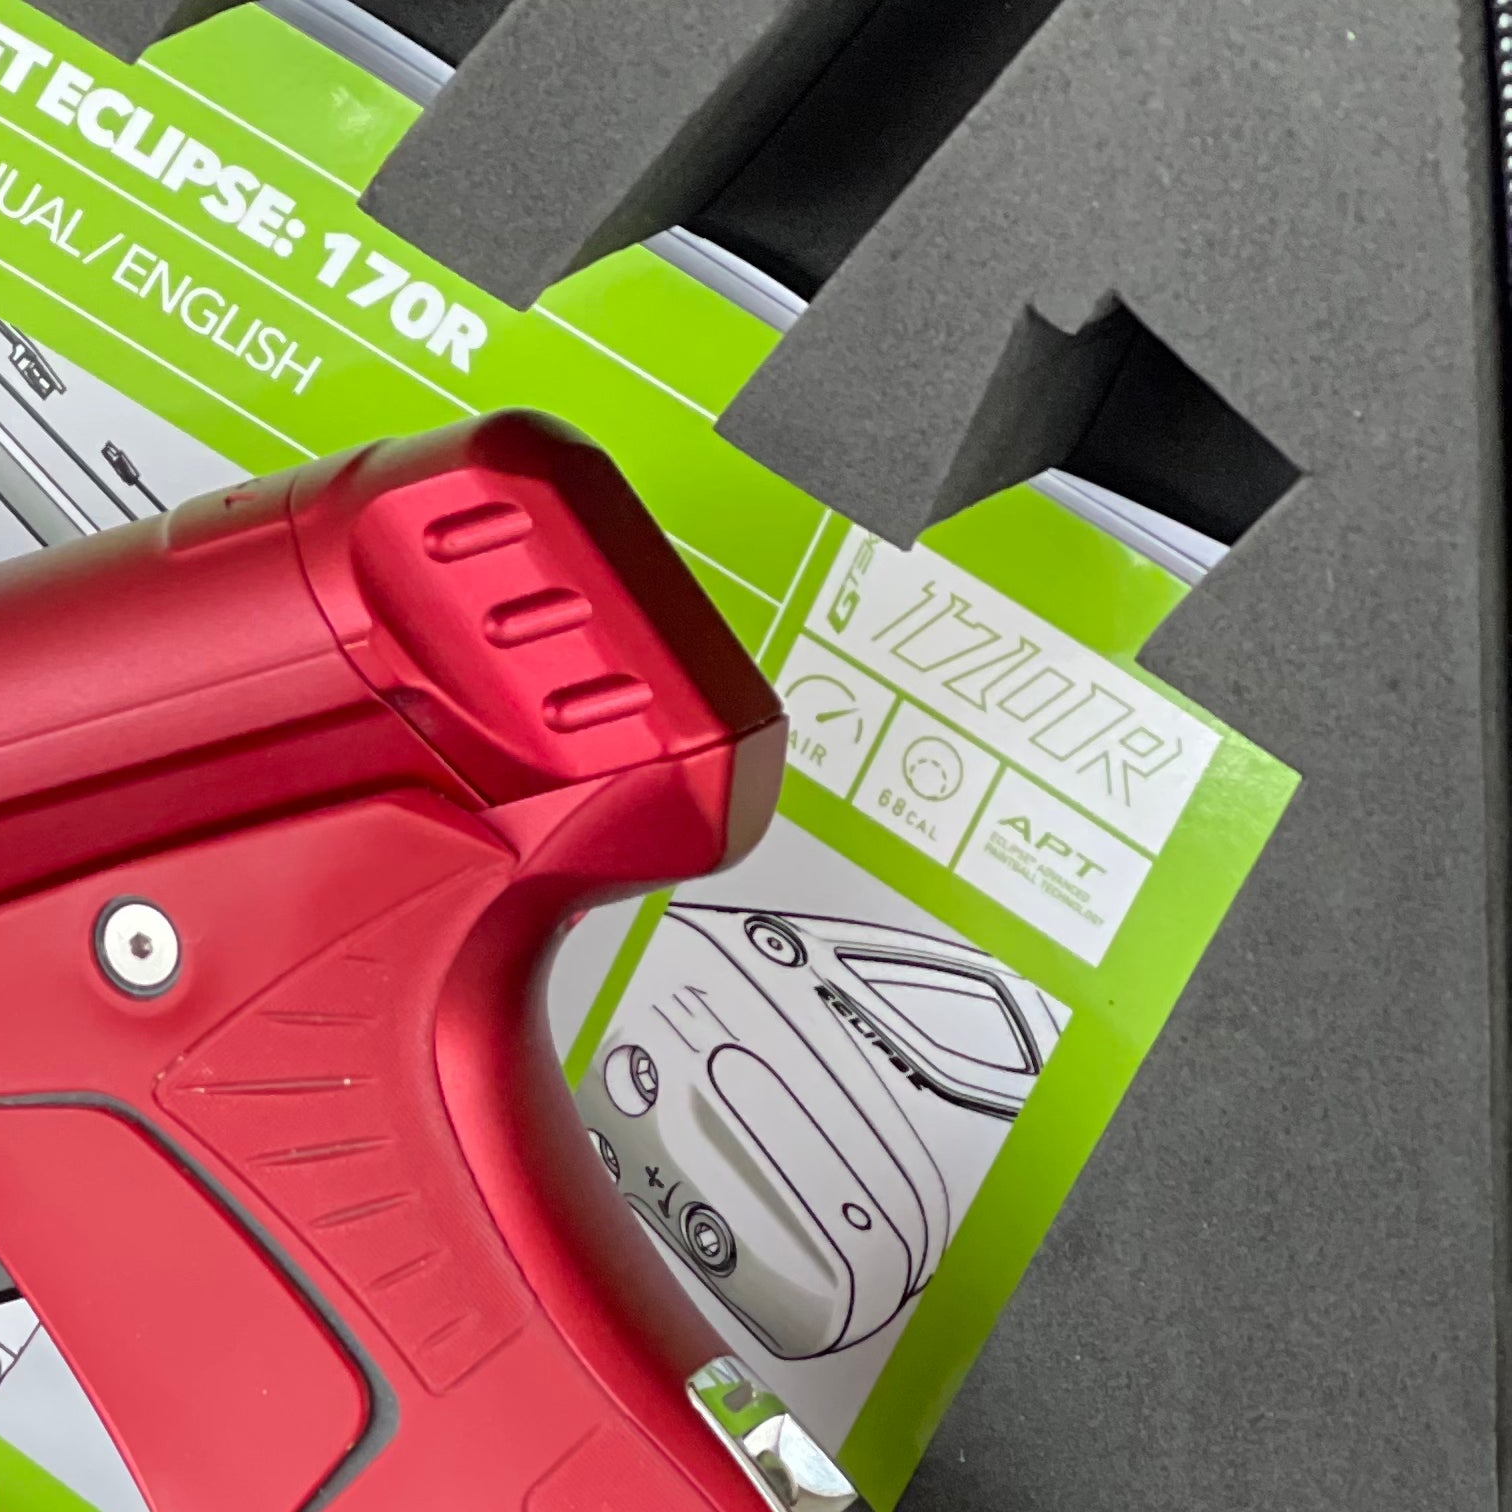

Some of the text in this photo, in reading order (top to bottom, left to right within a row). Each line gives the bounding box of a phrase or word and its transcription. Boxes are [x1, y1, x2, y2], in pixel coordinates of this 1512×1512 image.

[36, 61, 308, 259] ECLIPSE:
[319, 231, 491, 373] 170R
[112, 251, 324, 396] ENGLISH
[877, 788, 937, 842] 68CAL
[998, 816, 1107, 878] APT
